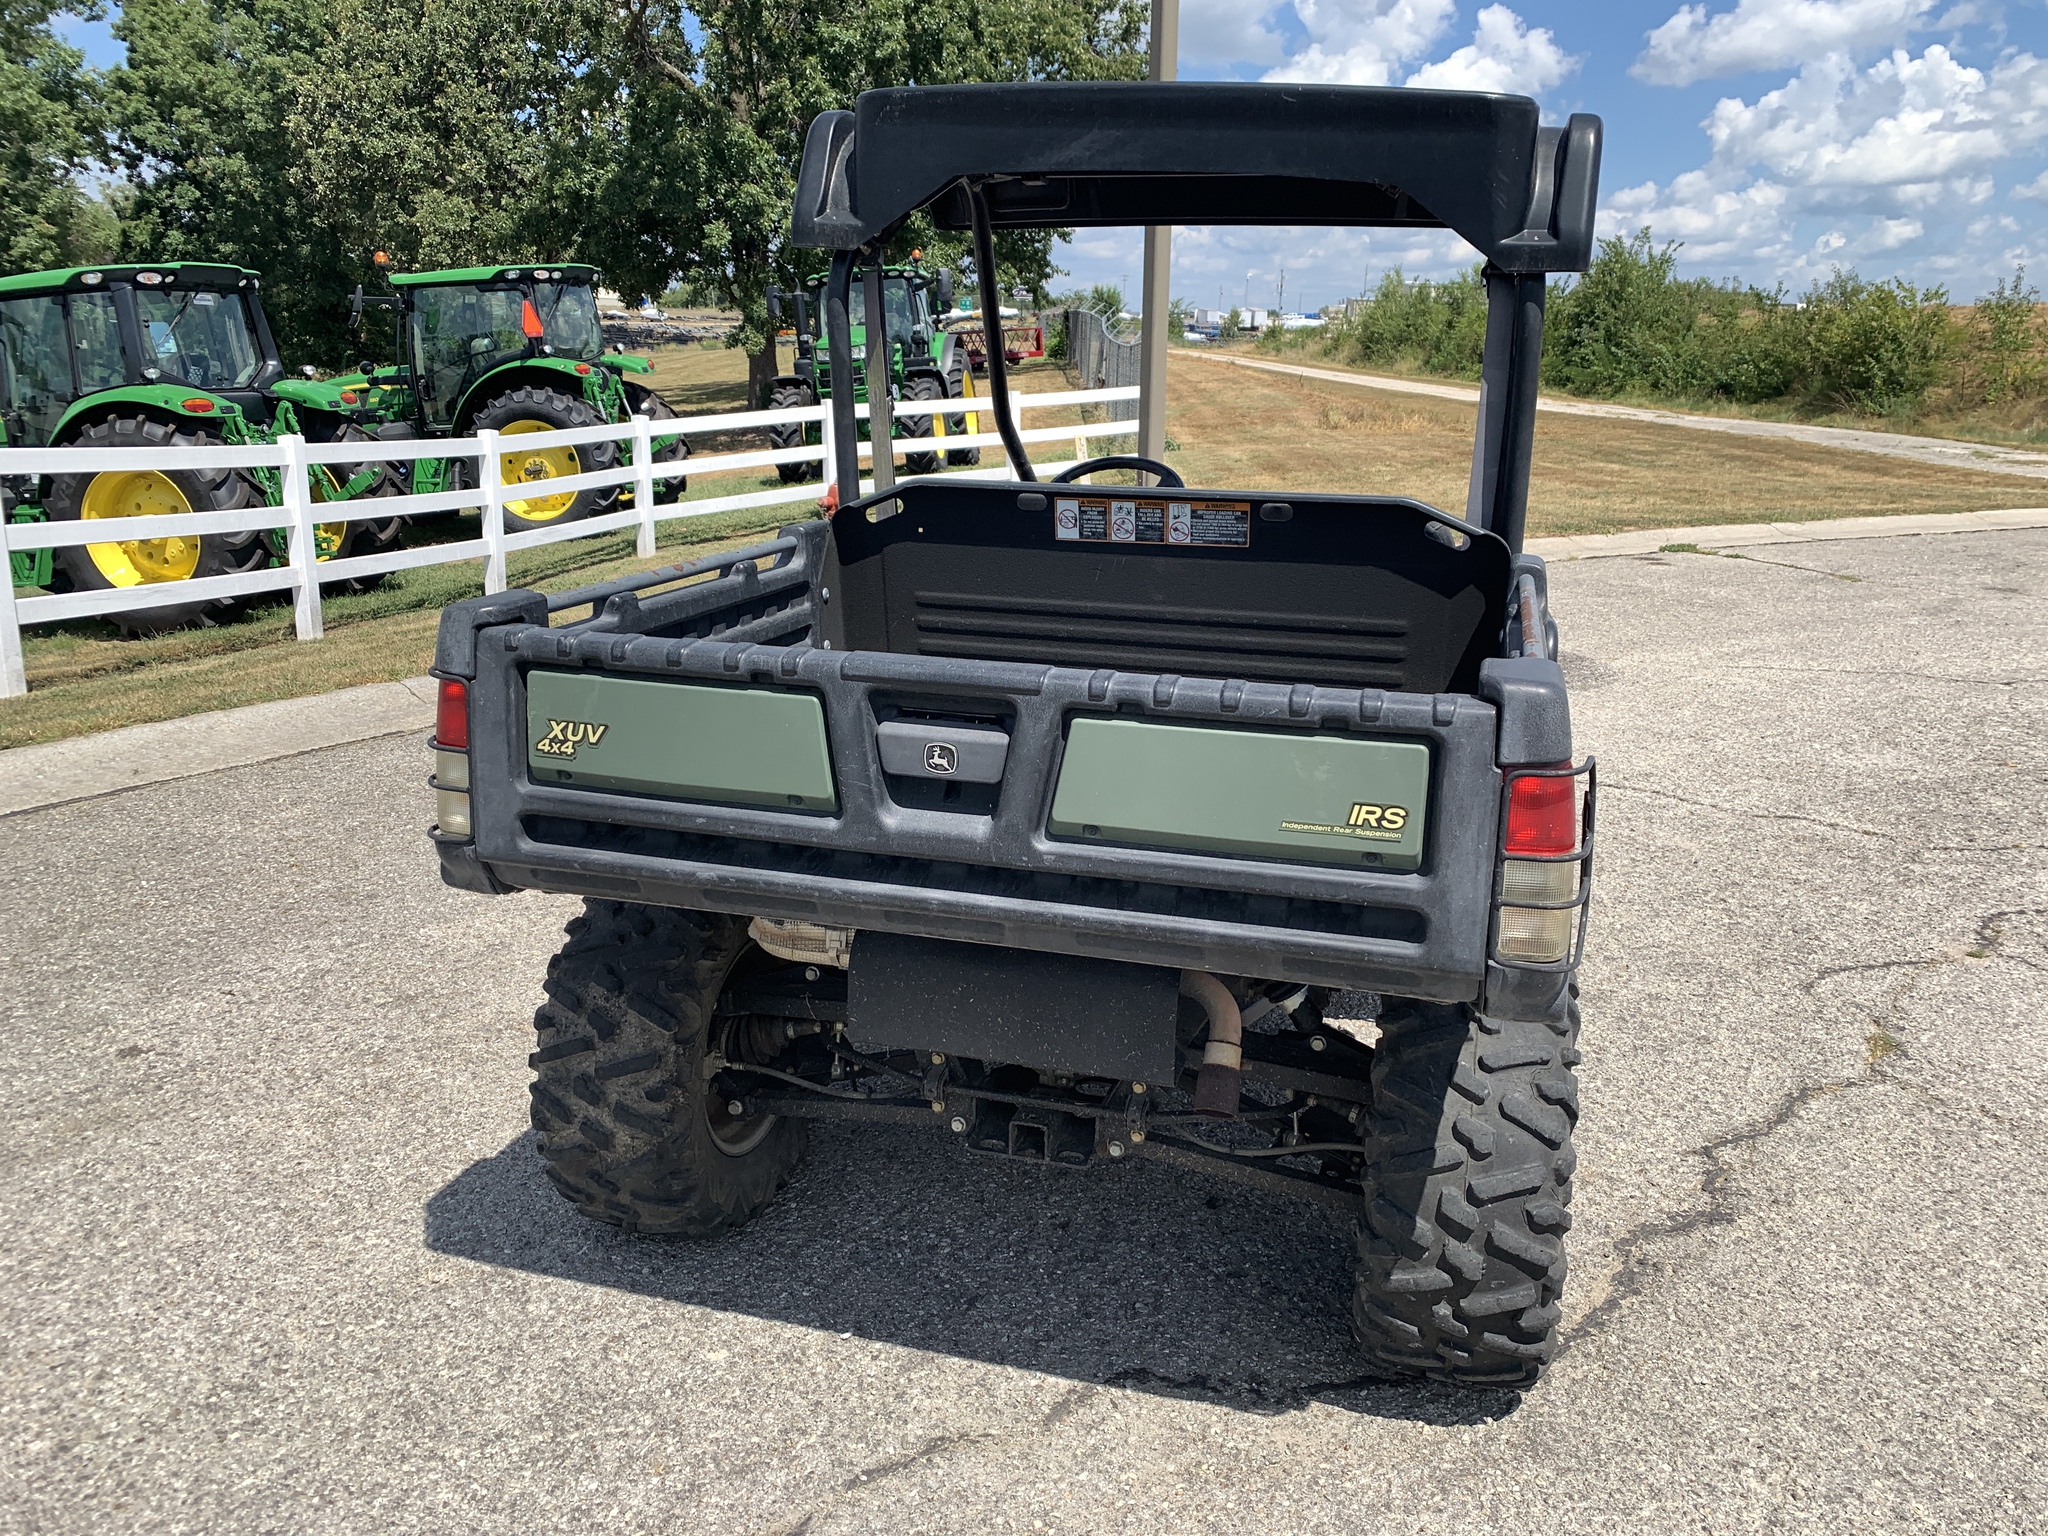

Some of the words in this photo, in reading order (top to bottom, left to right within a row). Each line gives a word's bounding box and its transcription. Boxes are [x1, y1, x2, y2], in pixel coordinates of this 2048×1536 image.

[547, 720, 605, 744] XUV
[537, 738, 575, 755] 4x4
[1348, 804, 1408, 830] IRS
[1281, 821, 1332, 833] Independent
[1333, 825, 1353, 835] Rear
[1354, 828, 1402, 839] Suspension
